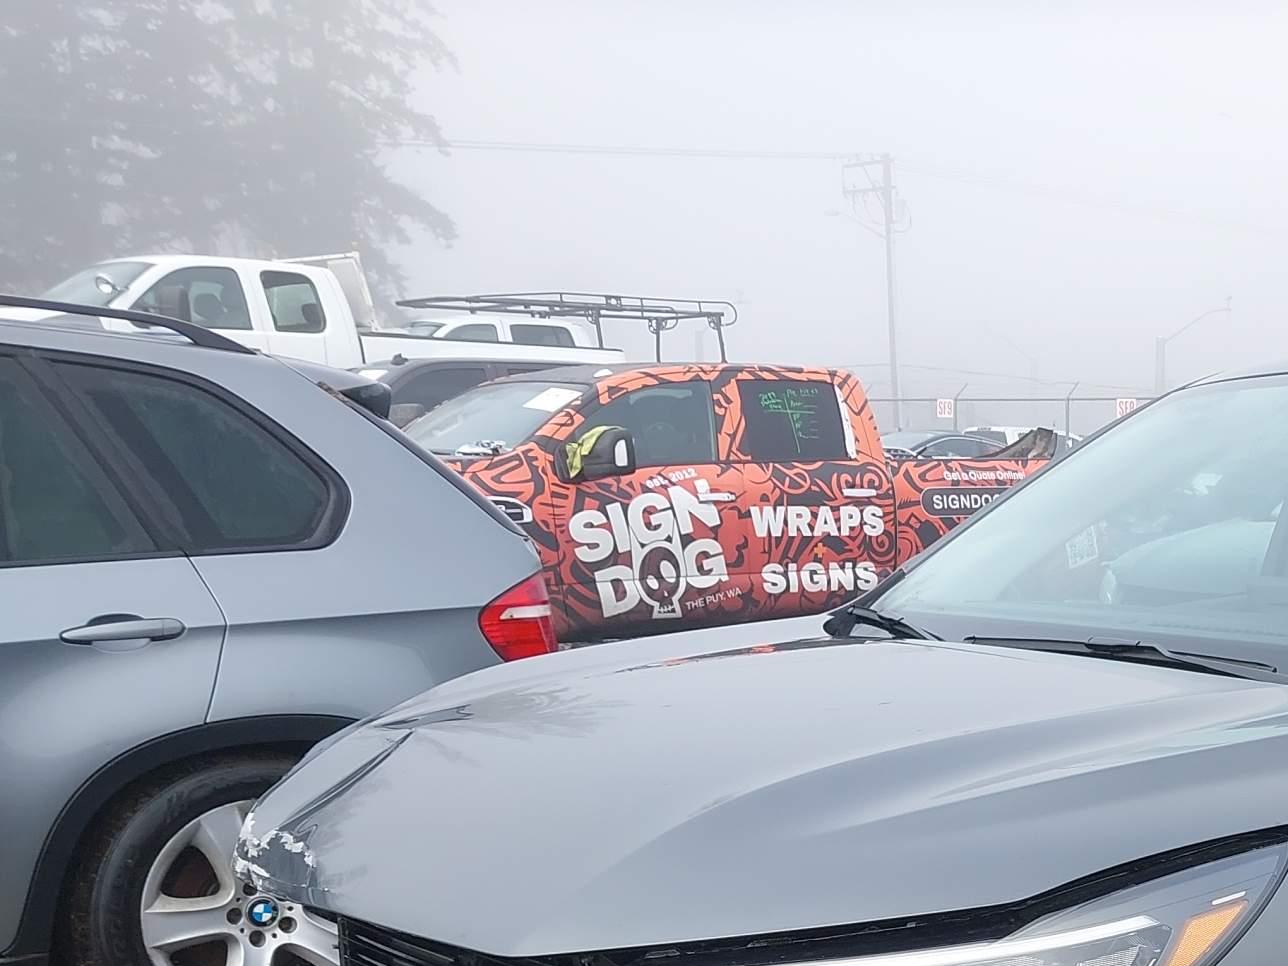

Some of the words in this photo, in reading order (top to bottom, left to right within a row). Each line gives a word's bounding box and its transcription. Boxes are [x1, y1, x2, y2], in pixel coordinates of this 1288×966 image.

[669, 467, 698, 482] 2012
[943, 470, 961, 481] Get
[962, 472, 969, 481] a
[969, 470, 995, 481] Quote
[568, 479, 721, 563] SIGN
[750, 505, 885, 537] WRAPS
[594, 538, 729, 618] DOG
[761, 561, 878, 594] SIGNS
[685, 597, 705, 610] THE
[726, 587, 742, 598] WA
